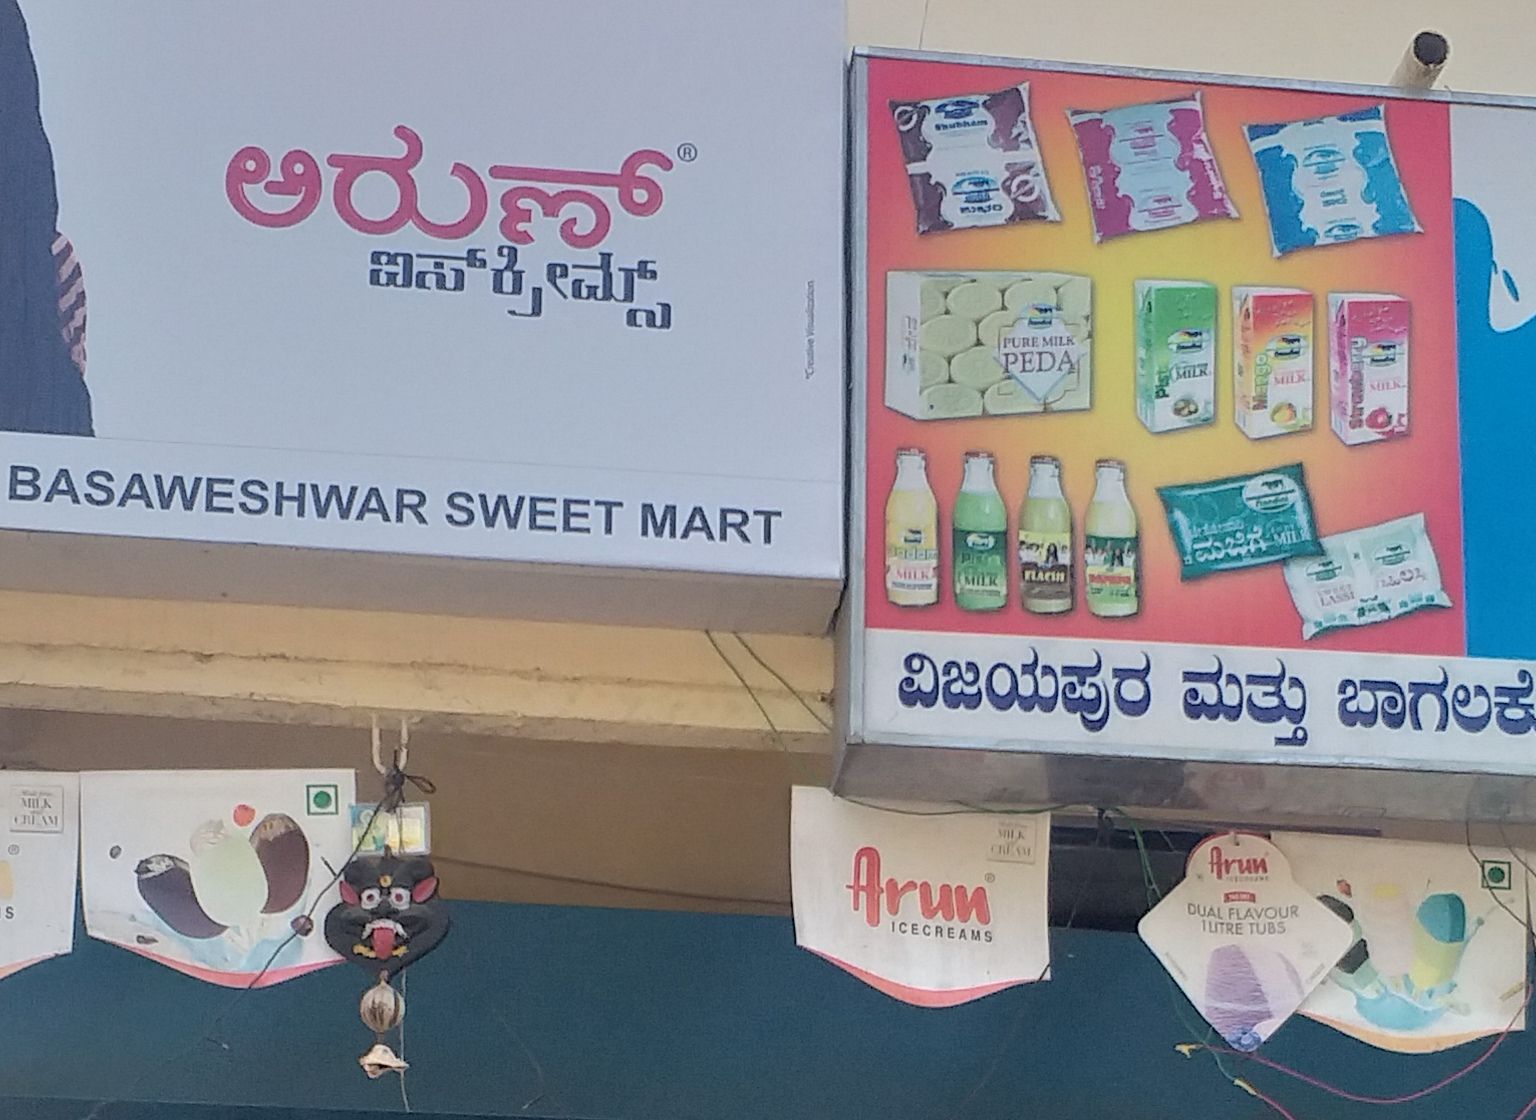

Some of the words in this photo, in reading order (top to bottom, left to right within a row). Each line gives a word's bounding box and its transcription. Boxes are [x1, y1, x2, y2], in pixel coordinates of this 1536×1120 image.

[225, 125, 674, 250] ಅರುಣ್
[1002, 336, 1039, 348] PURE
[1041, 335, 1076, 347] MILK
[1002, 350, 1077, 374] PEDA
[8, 463, 429, 527] BASAWESHWAR
[445, 497, 624, 538] SWEET
[640, 503, 783, 546] MART
[897, 645, 1154, 733] ವಿಜಯಪುರ
[1181, 654, 1310, 748] ಮತ್ತು
[1208, 846, 1268, 880] Arun
[846, 847, 991, 928] Arun
[1187, 902, 1226, 920] DUAL
[1228, 905, 1299, 921] FLAVOUR
[891, 921, 994, 943] ICECREAMS
[1208, 921, 1244, 935] LITRE
[1248, 921, 1286, 935] TUBS
